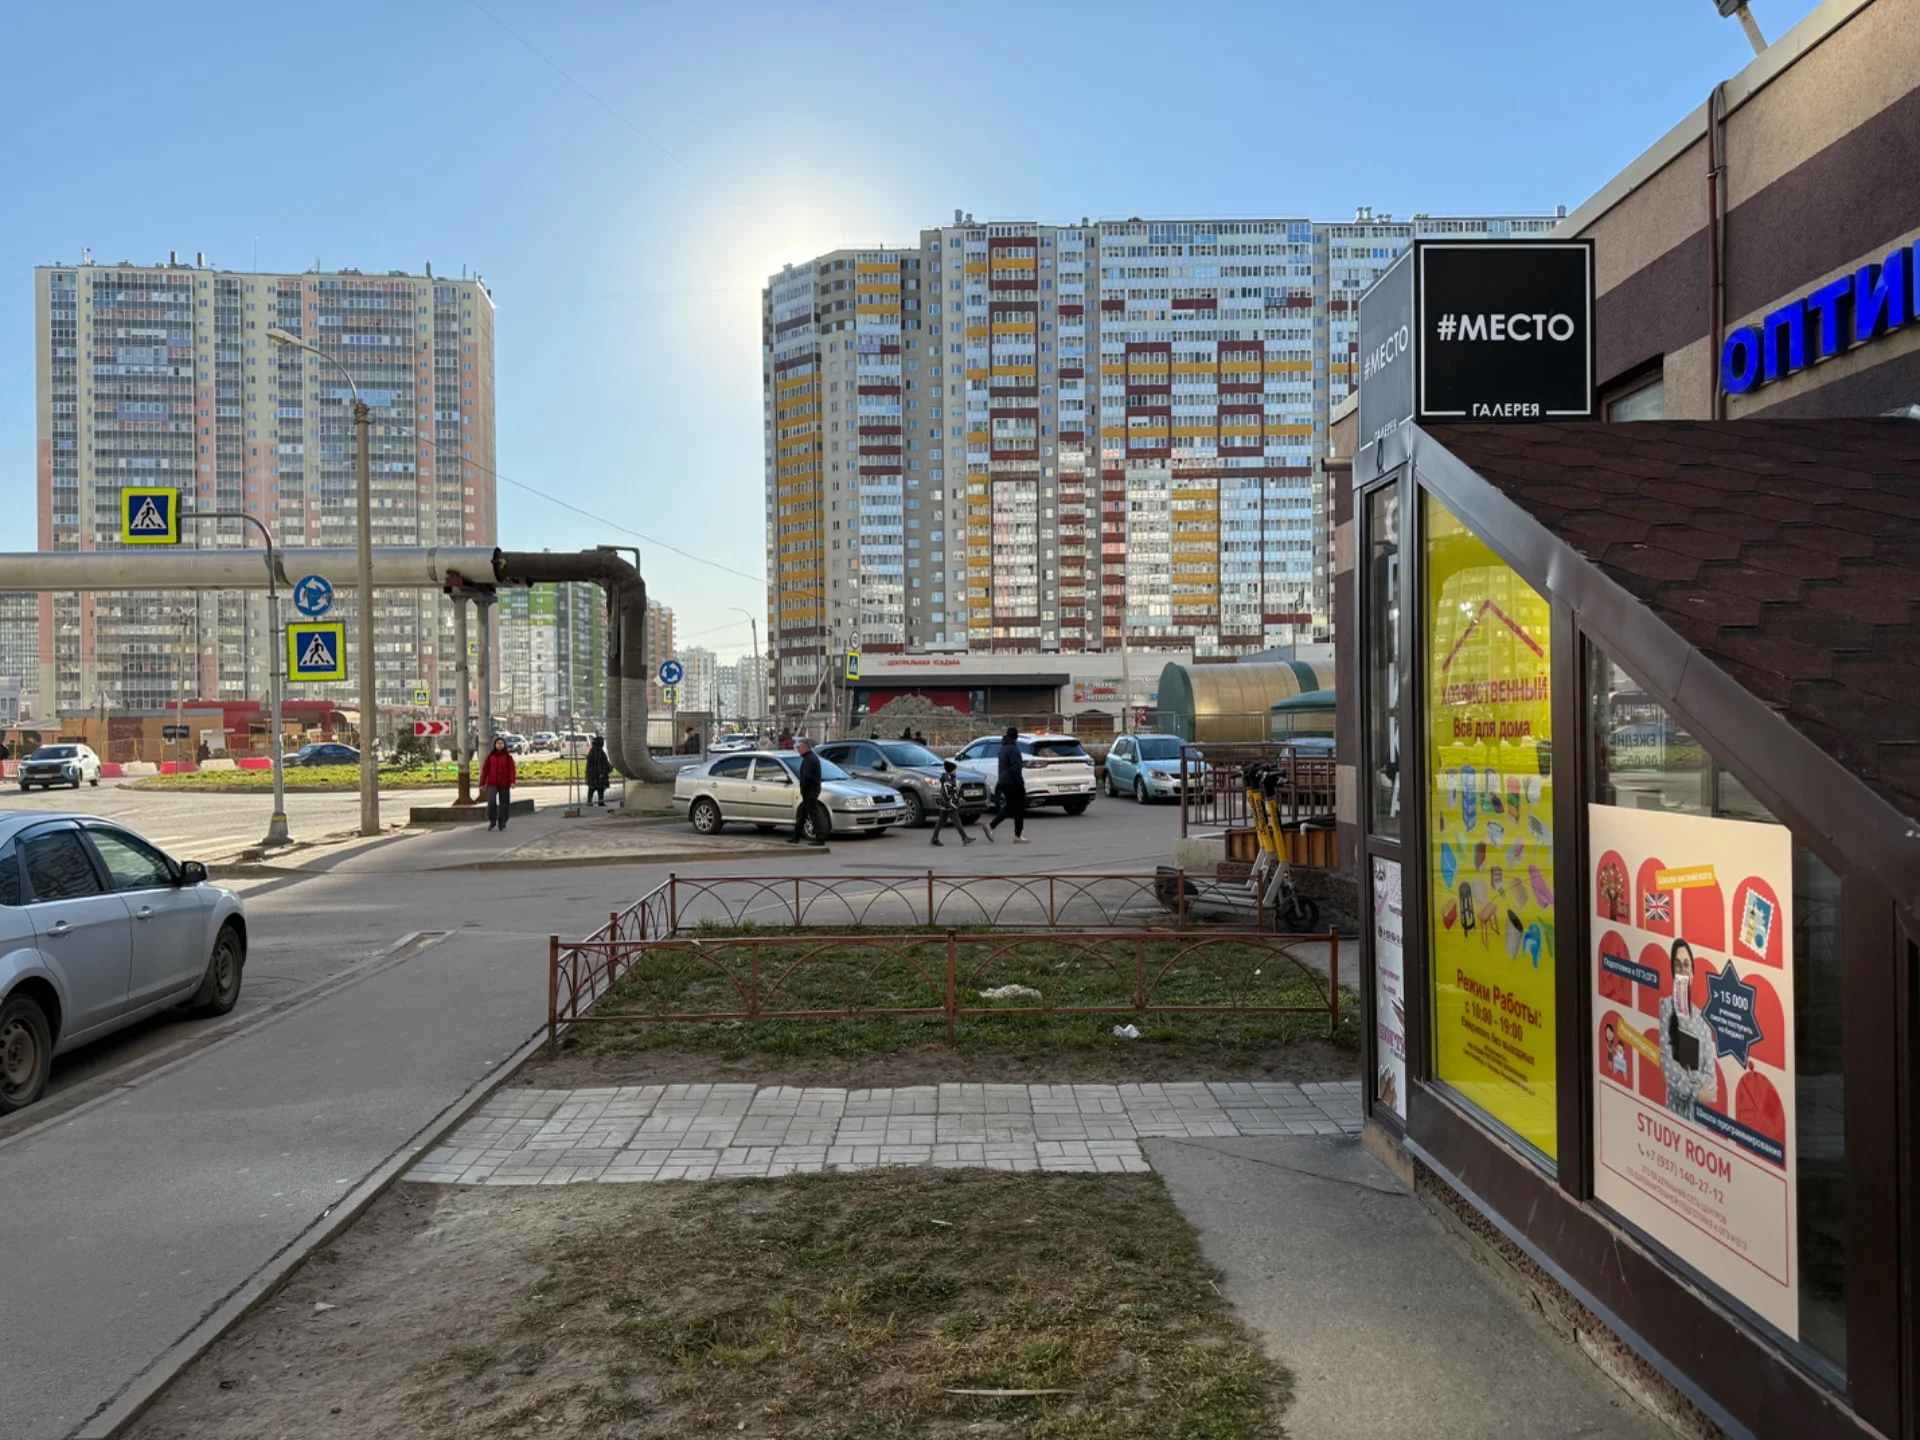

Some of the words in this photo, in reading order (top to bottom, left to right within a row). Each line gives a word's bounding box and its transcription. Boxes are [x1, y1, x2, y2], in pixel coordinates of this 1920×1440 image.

[1437, 313, 1575, 341] #МЕСТО
[1364, 325, 1409, 382] #МЕСТО
[1473, 403, 1539, 417] ГАЛЕРЕЯ
[1453, 716, 1473, 738] Всё
[1475, 720, 1496, 741] для
[1499, 720, 1531, 739] дома
[1457, 968, 1490, 1003] Режим
[1493, 984, 1542, 1029] Работы:
[1720, 990, 1731, 1005] 15
[1732, 994, 1749, 1011] 000
[1500, 1016, 1523, 1042] 19:00
[1695, 1106, 1717, 1125] Школа
[1717, 1119, 1782, 1160] программирования
[1637, 1112, 1682, 1152] STUDY
[1685, 1138, 1731, 1184] ROOM
